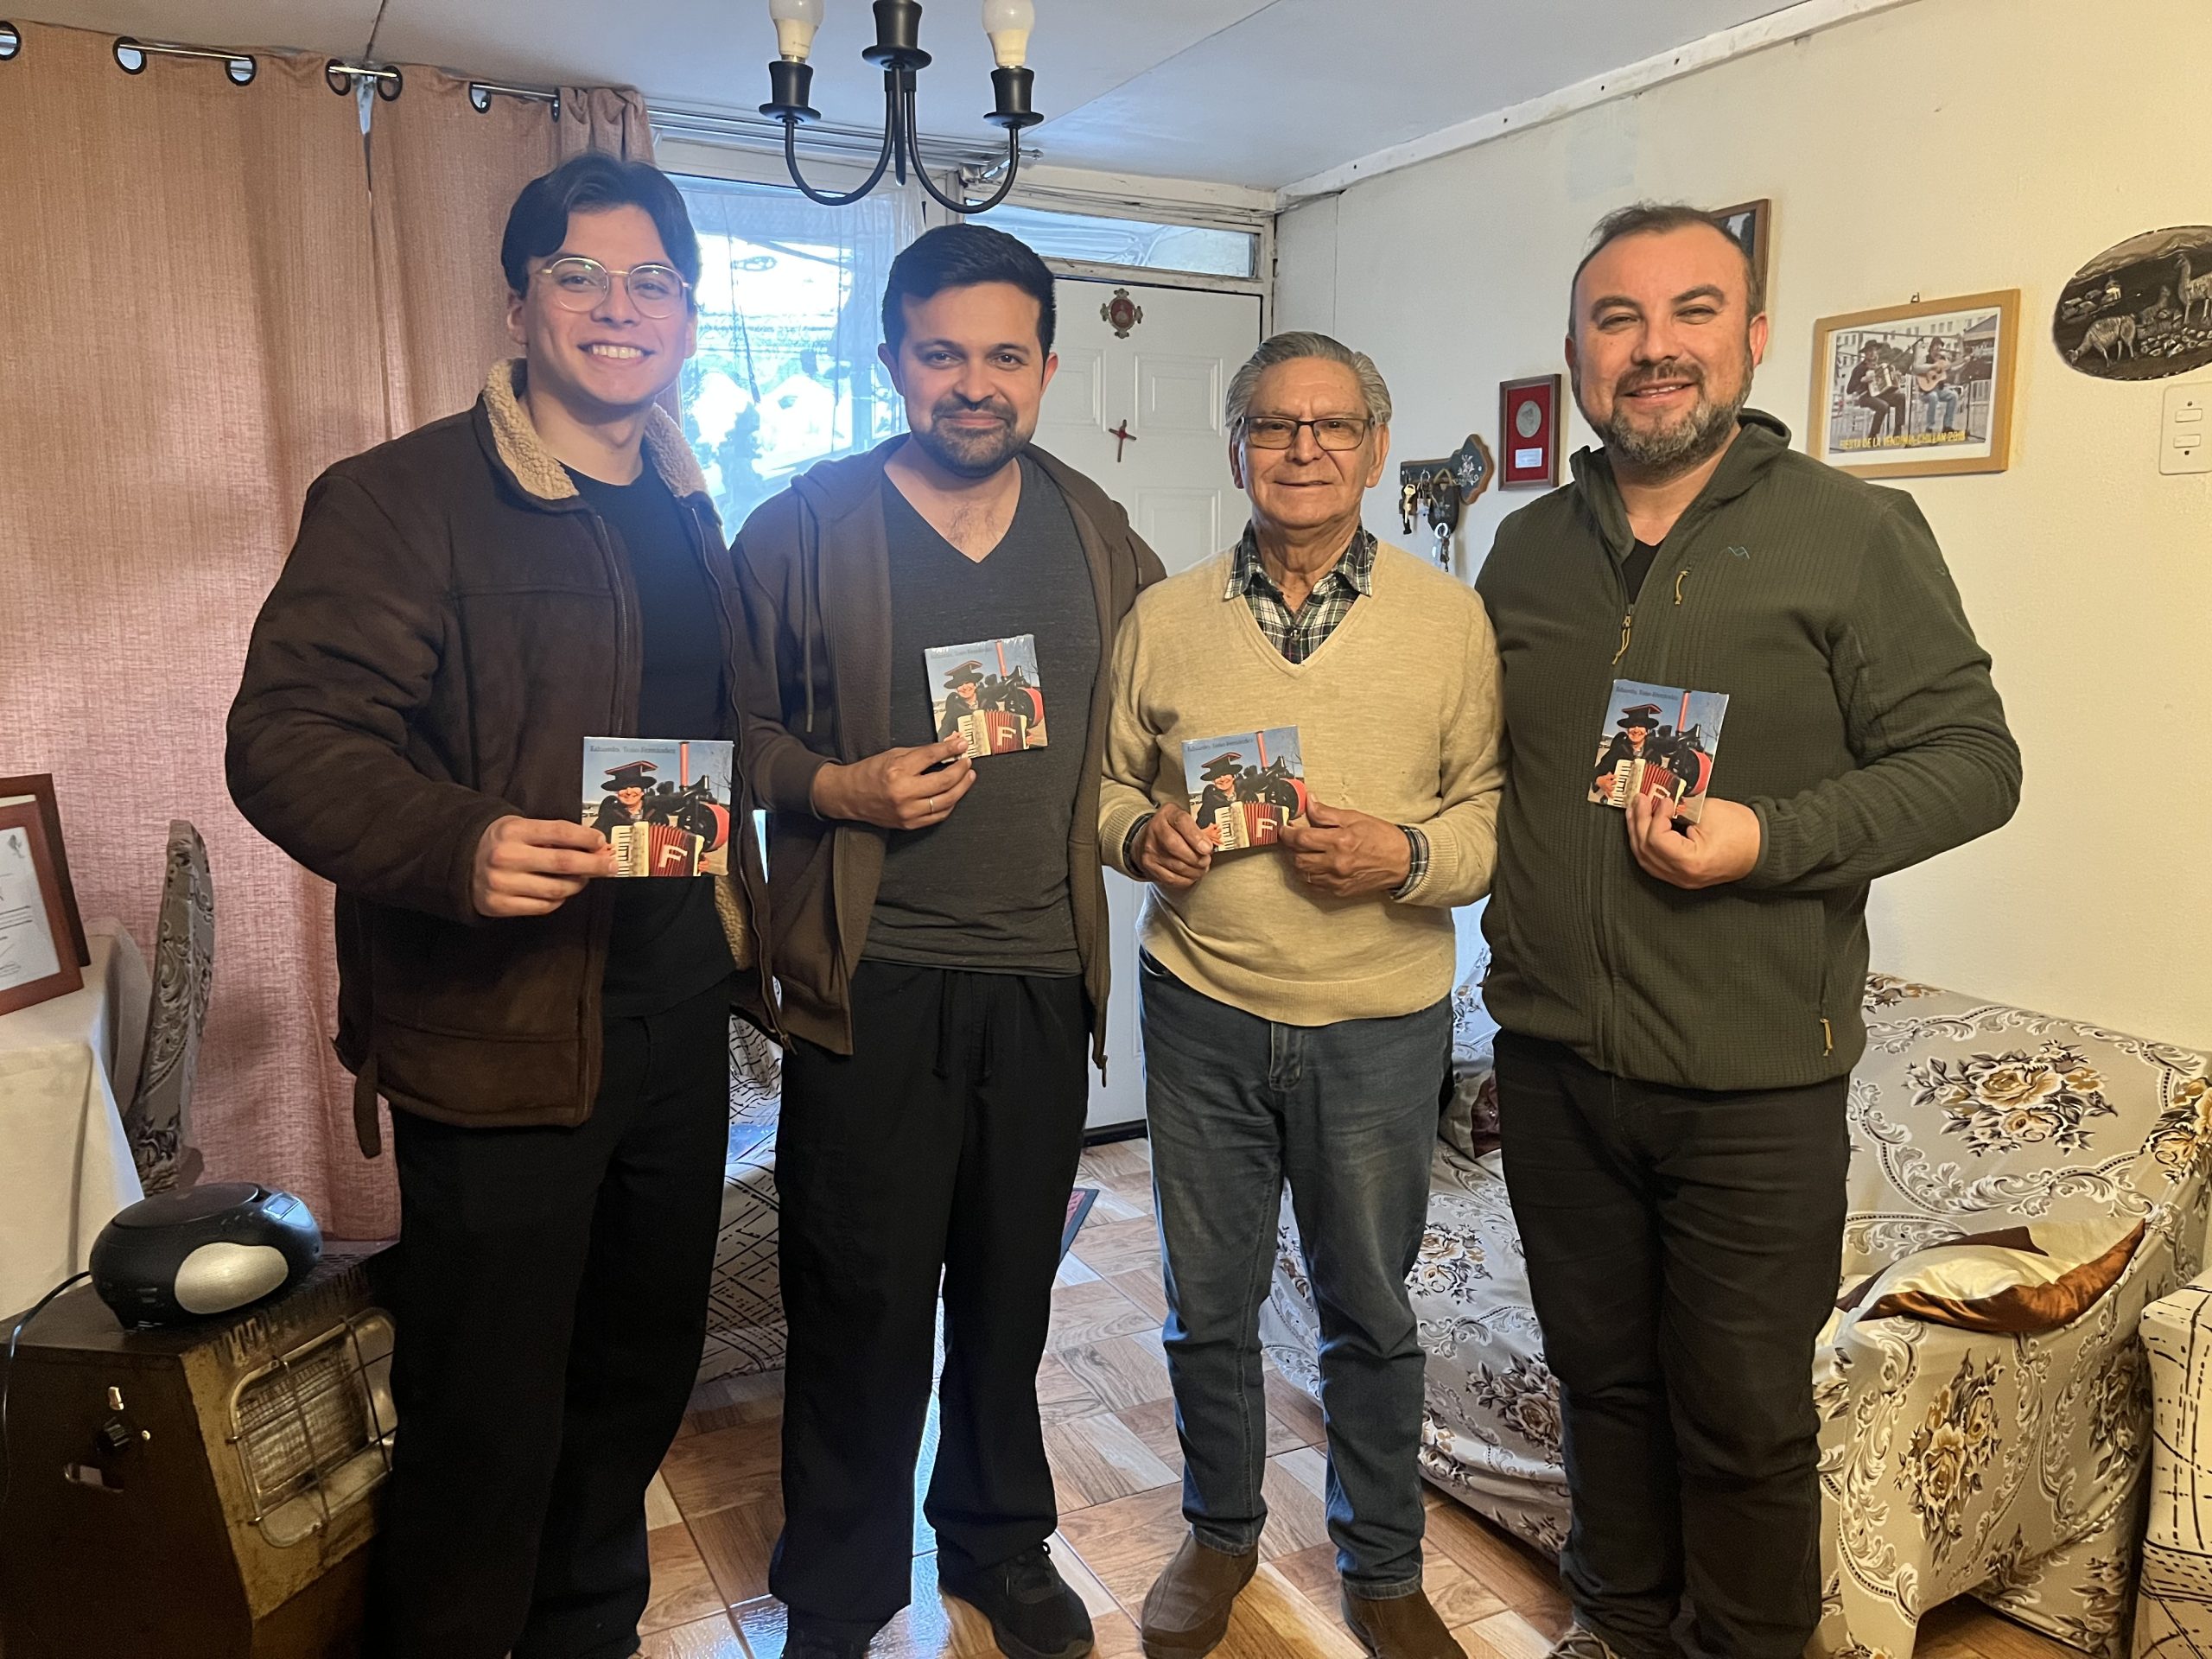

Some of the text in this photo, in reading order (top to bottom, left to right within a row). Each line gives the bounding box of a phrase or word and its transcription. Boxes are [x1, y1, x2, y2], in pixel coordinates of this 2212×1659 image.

[1862, 437, 1872, 448] DE
[1872, 436, 1881, 448] LA
[997, 726, 1017, 747] F
[1256, 817, 1278, 838] F
[658, 844, 688, 868] F
